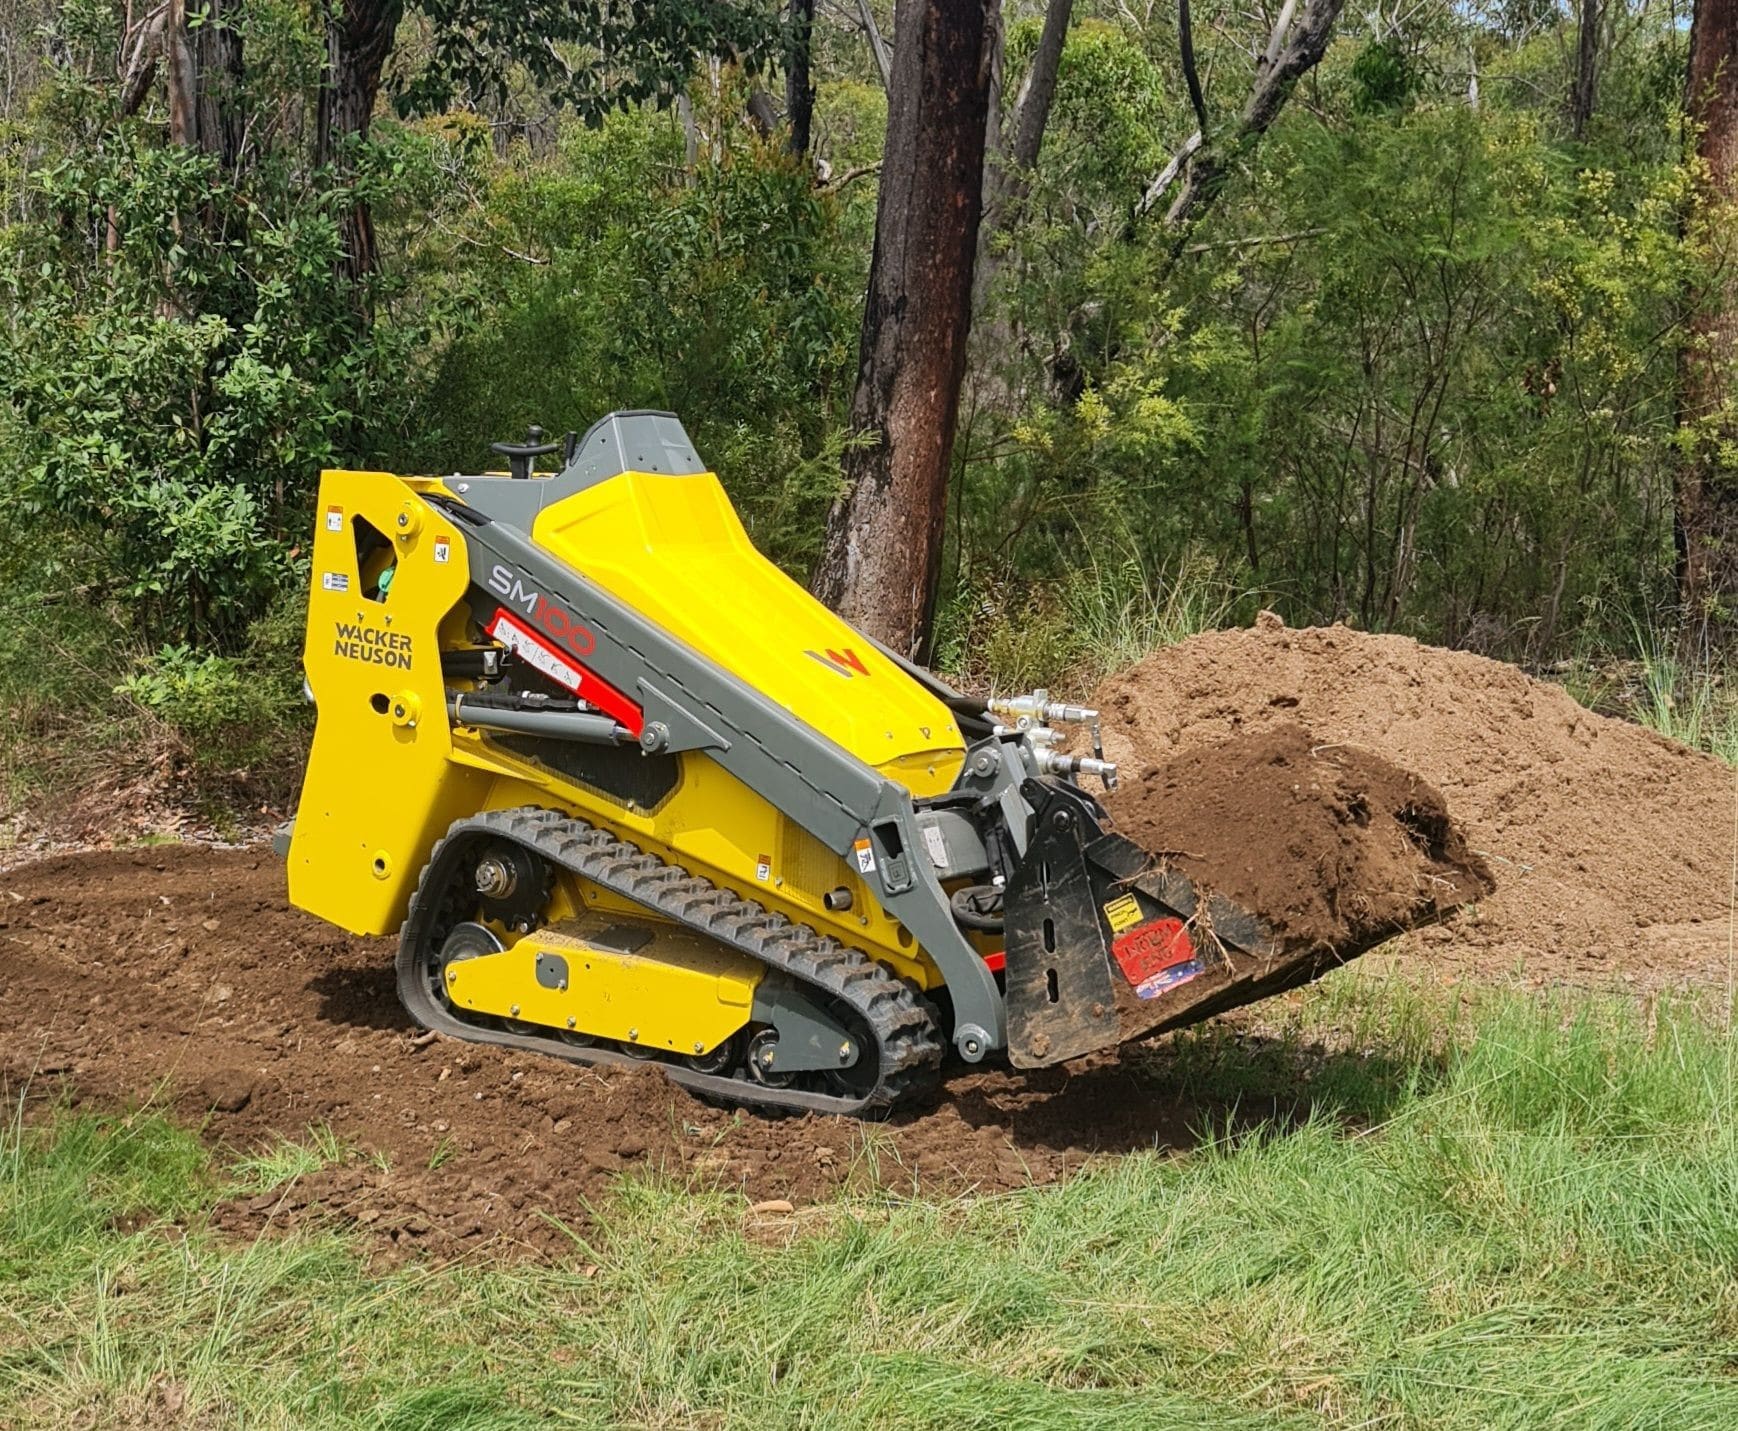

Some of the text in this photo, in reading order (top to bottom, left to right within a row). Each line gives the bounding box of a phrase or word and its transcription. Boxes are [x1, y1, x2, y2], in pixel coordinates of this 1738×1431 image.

[488, 564, 596, 656] SM100
[335, 622, 412, 652] WACKER
[334, 640, 412, 670] NEUSON
